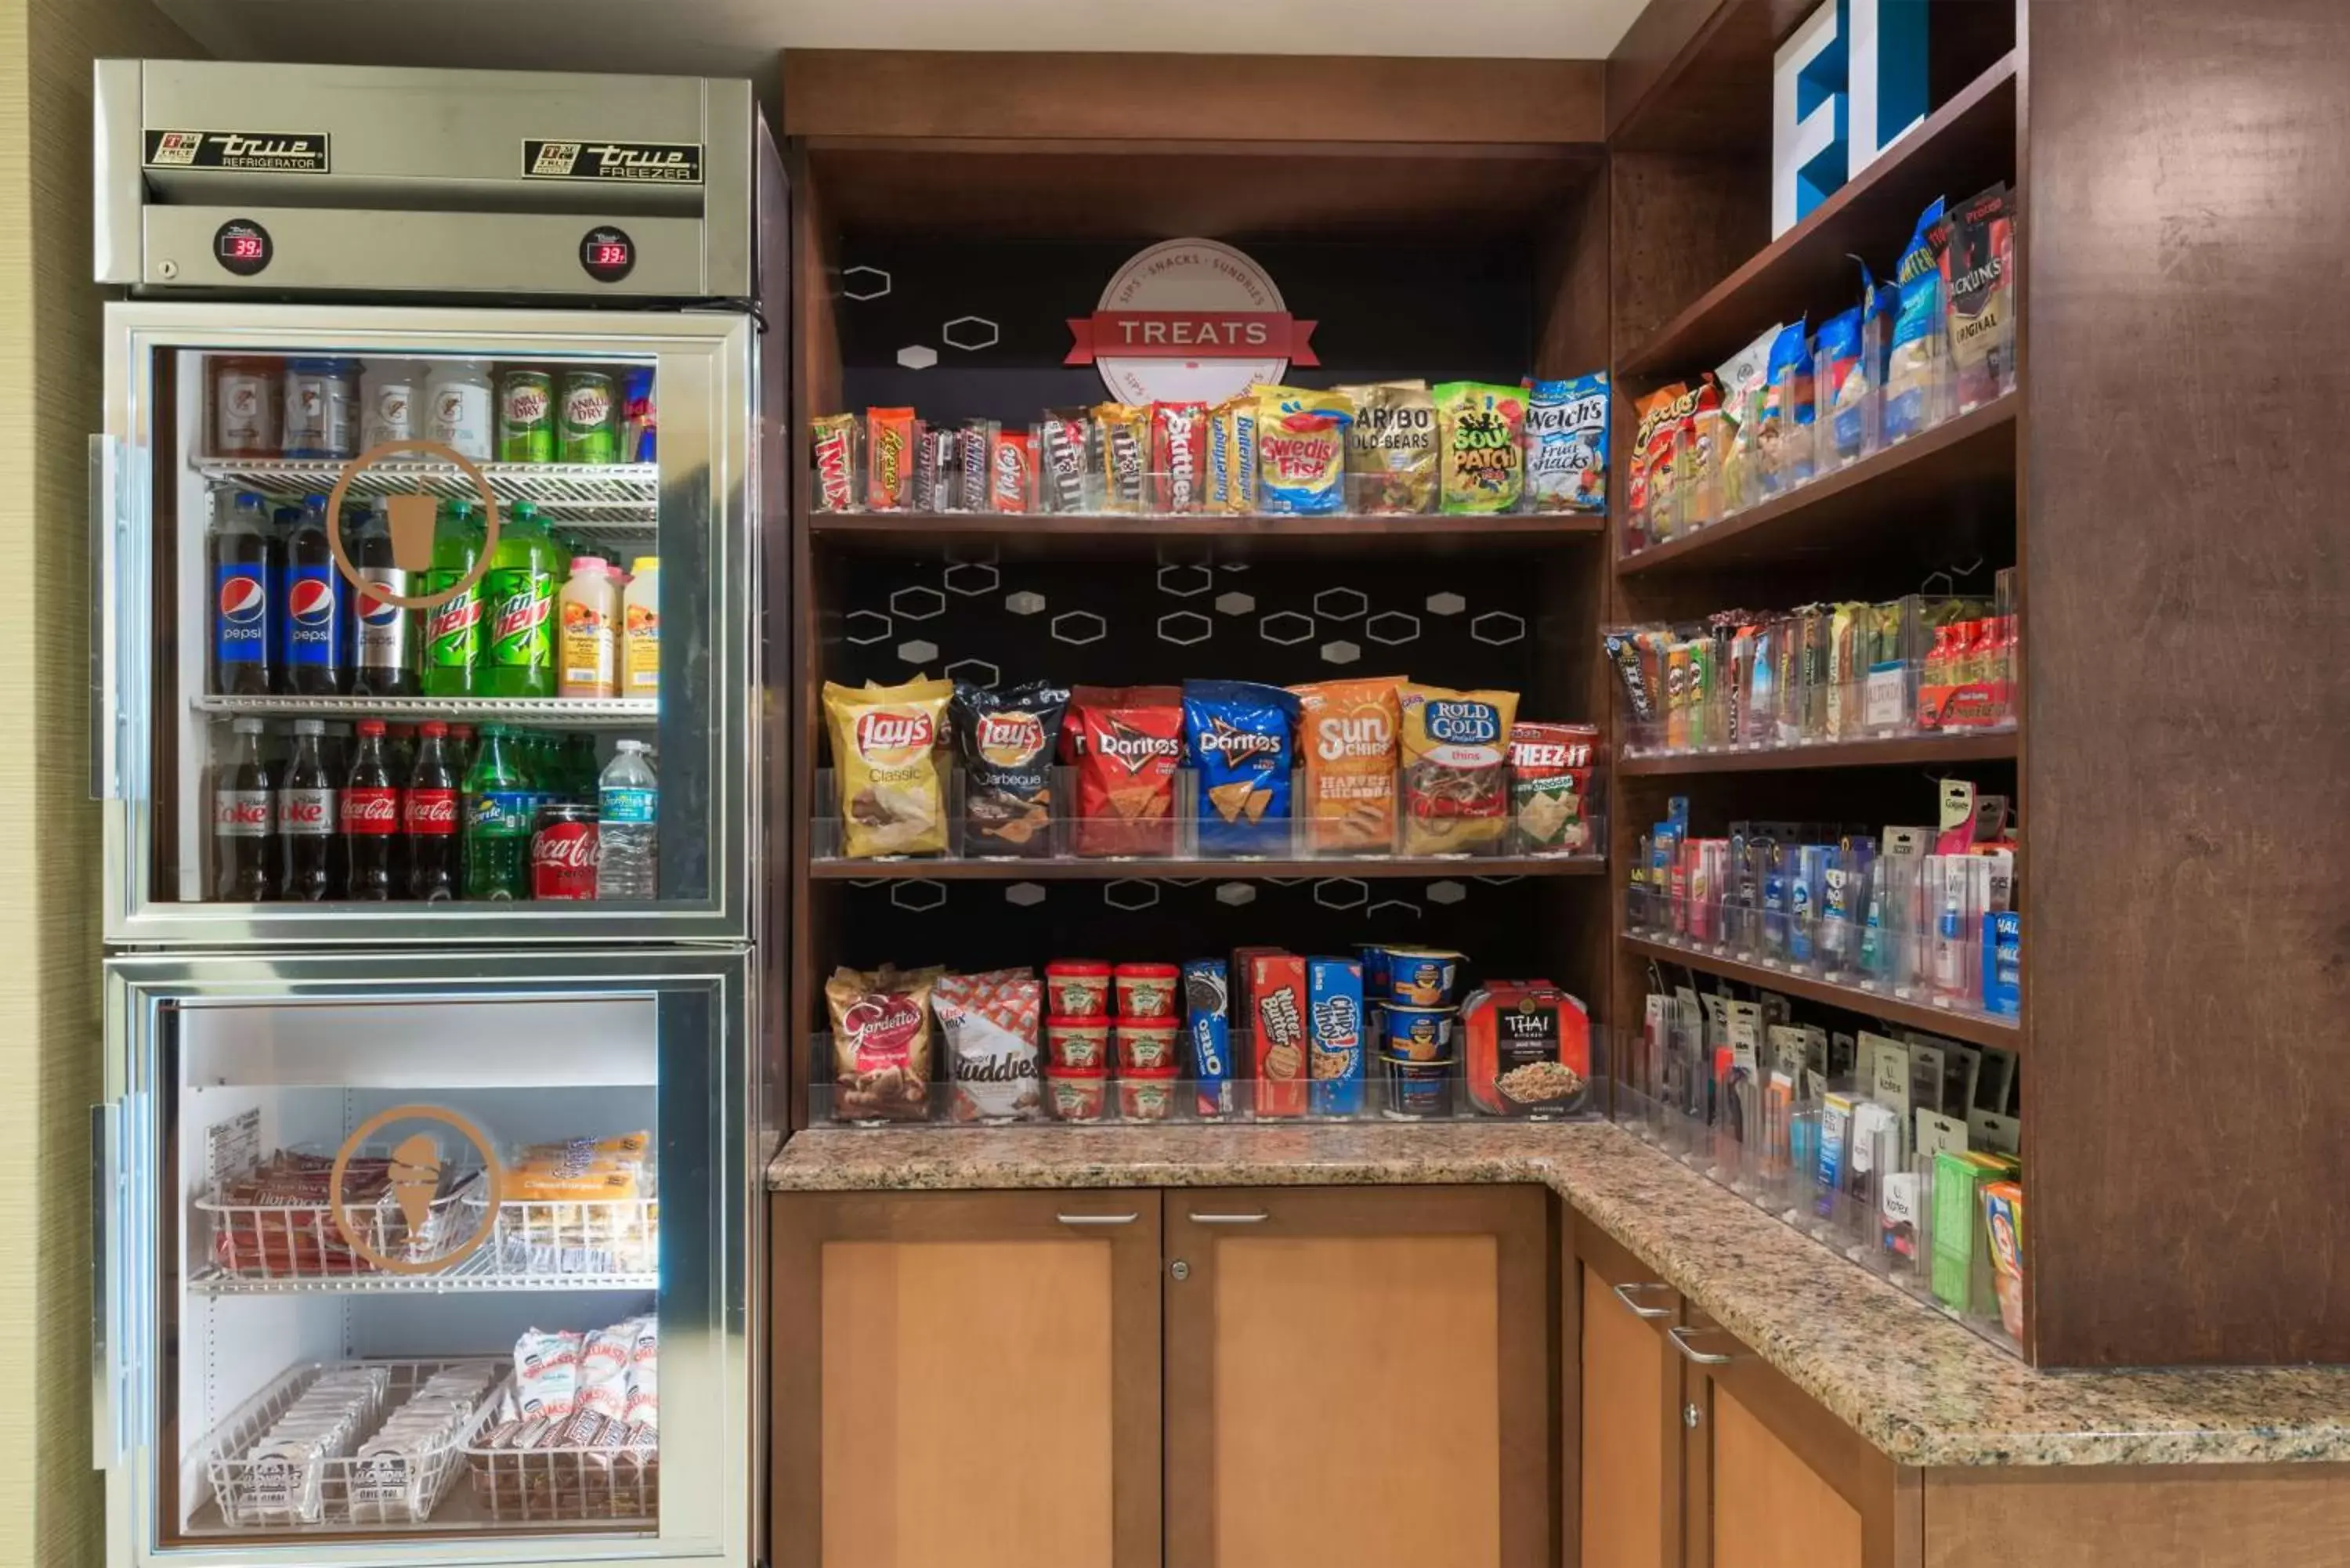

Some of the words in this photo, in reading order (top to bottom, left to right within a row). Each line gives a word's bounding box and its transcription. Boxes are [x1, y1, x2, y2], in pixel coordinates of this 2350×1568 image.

[208, 134, 316, 157] true
[587, 145, 691, 167] true
[223, 157, 315, 168] REFRIGERATOR
[599, 167, 690, 179] FREEZER
[1119, 281, 1141, 304] SIPS
[1148, 254, 1201, 276] SNACKS
[1213, 258, 1266, 307] SUNDRIES
[1118, 320, 1267, 345] TREATS
[577, 407, 603, 421] DRY
[1355, 407, 1430, 429] ARIBO
[1526, 399, 1603, 431] Welch's
[1454, 429, 1512, 448] SOUR
[1165, 408, 1194, 512] Skittles
[1213, 417, 1228, 502] Butterfinger
[1237, 416, 1254, 502] Butterfinger
[1453, 449, 1517, 469] PATCH
[1531, 453, 1589, 470] Snacks
[1540, 444, 1580, 459] Fruit
[814, 428, 851, 513] TWIX
[1277, 459, 1326, 479] Fish
[223, 627, 262, 643] pepsi
[292, 630, 331, 644] pepsi
[359, 633, 396, 647] pepsi
[1437, 703, 1490, 719] ROLD
[862, 714, 929, 750] Lay's
[982, 720, 1039, 750] Lay's
[1318, 717, 1391, 761] Sun
[1432, 719, 1495, 740] GOLD
[1100, 733, 1179, 756] Doritos
[1201, 732, 1282, 753] Doritos
[1346, 742, 1392, 756] CHIPS
[1452, 750, 1481, 761] thins
[869, 768, 922, 783] Classic
[1945, 798, 1969, 811] Colgate
[1260, 996, 1291, 1047] Butter
[1276, 988, 1303, 1040] Nutter
[1330, 996, 1355, 1038] Chips
[1505, 1016, 1549, 1033] THAI
[1198, 1019, 1222, 1075] OREO
[1885, 1200, 1911, 1216] kotex
